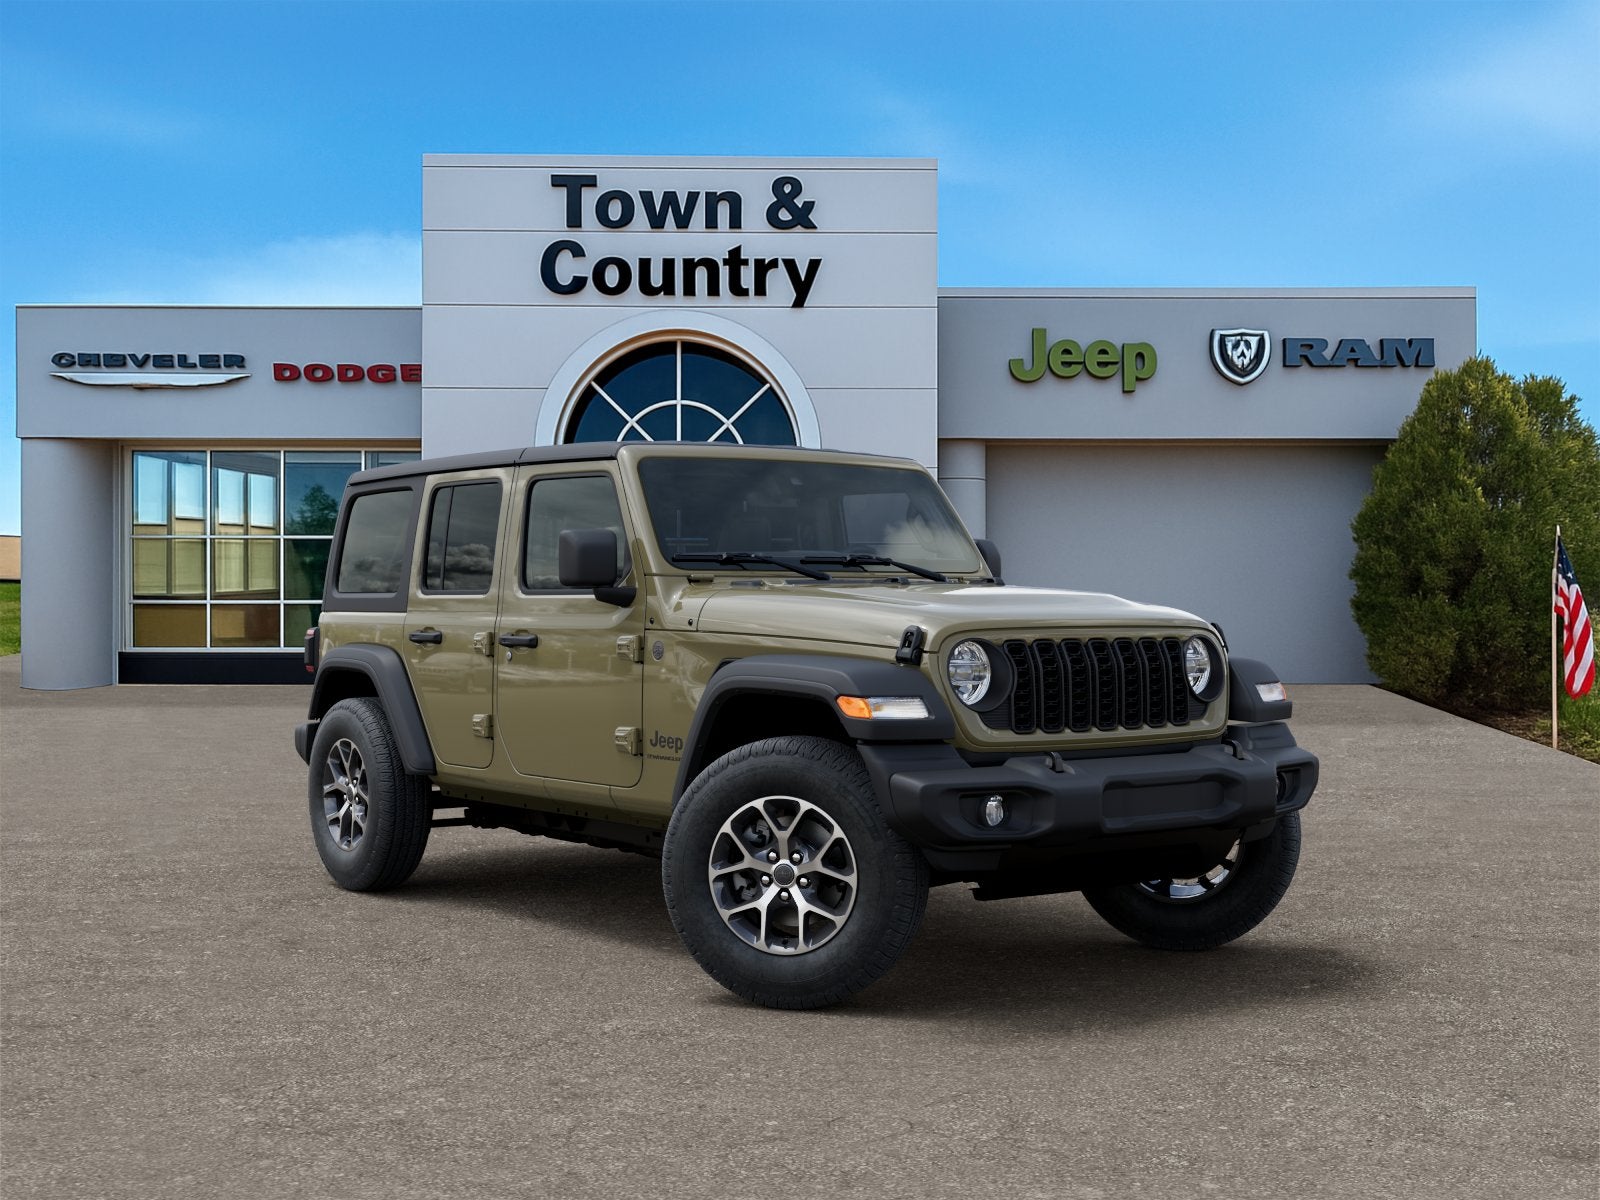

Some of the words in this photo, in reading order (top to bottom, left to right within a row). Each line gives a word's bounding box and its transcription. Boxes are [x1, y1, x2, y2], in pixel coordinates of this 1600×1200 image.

[550, 174, 743, 230] Town
[765, 176, 818, 230] &
[540, 239, 822, 309] Country
[273, 362, 422, 383] DODGE
[1008, 328, 1158, 393] Jeep
[1282, 337, 1436, 368] RAM
[649, 730, 684, 754] Jeep
